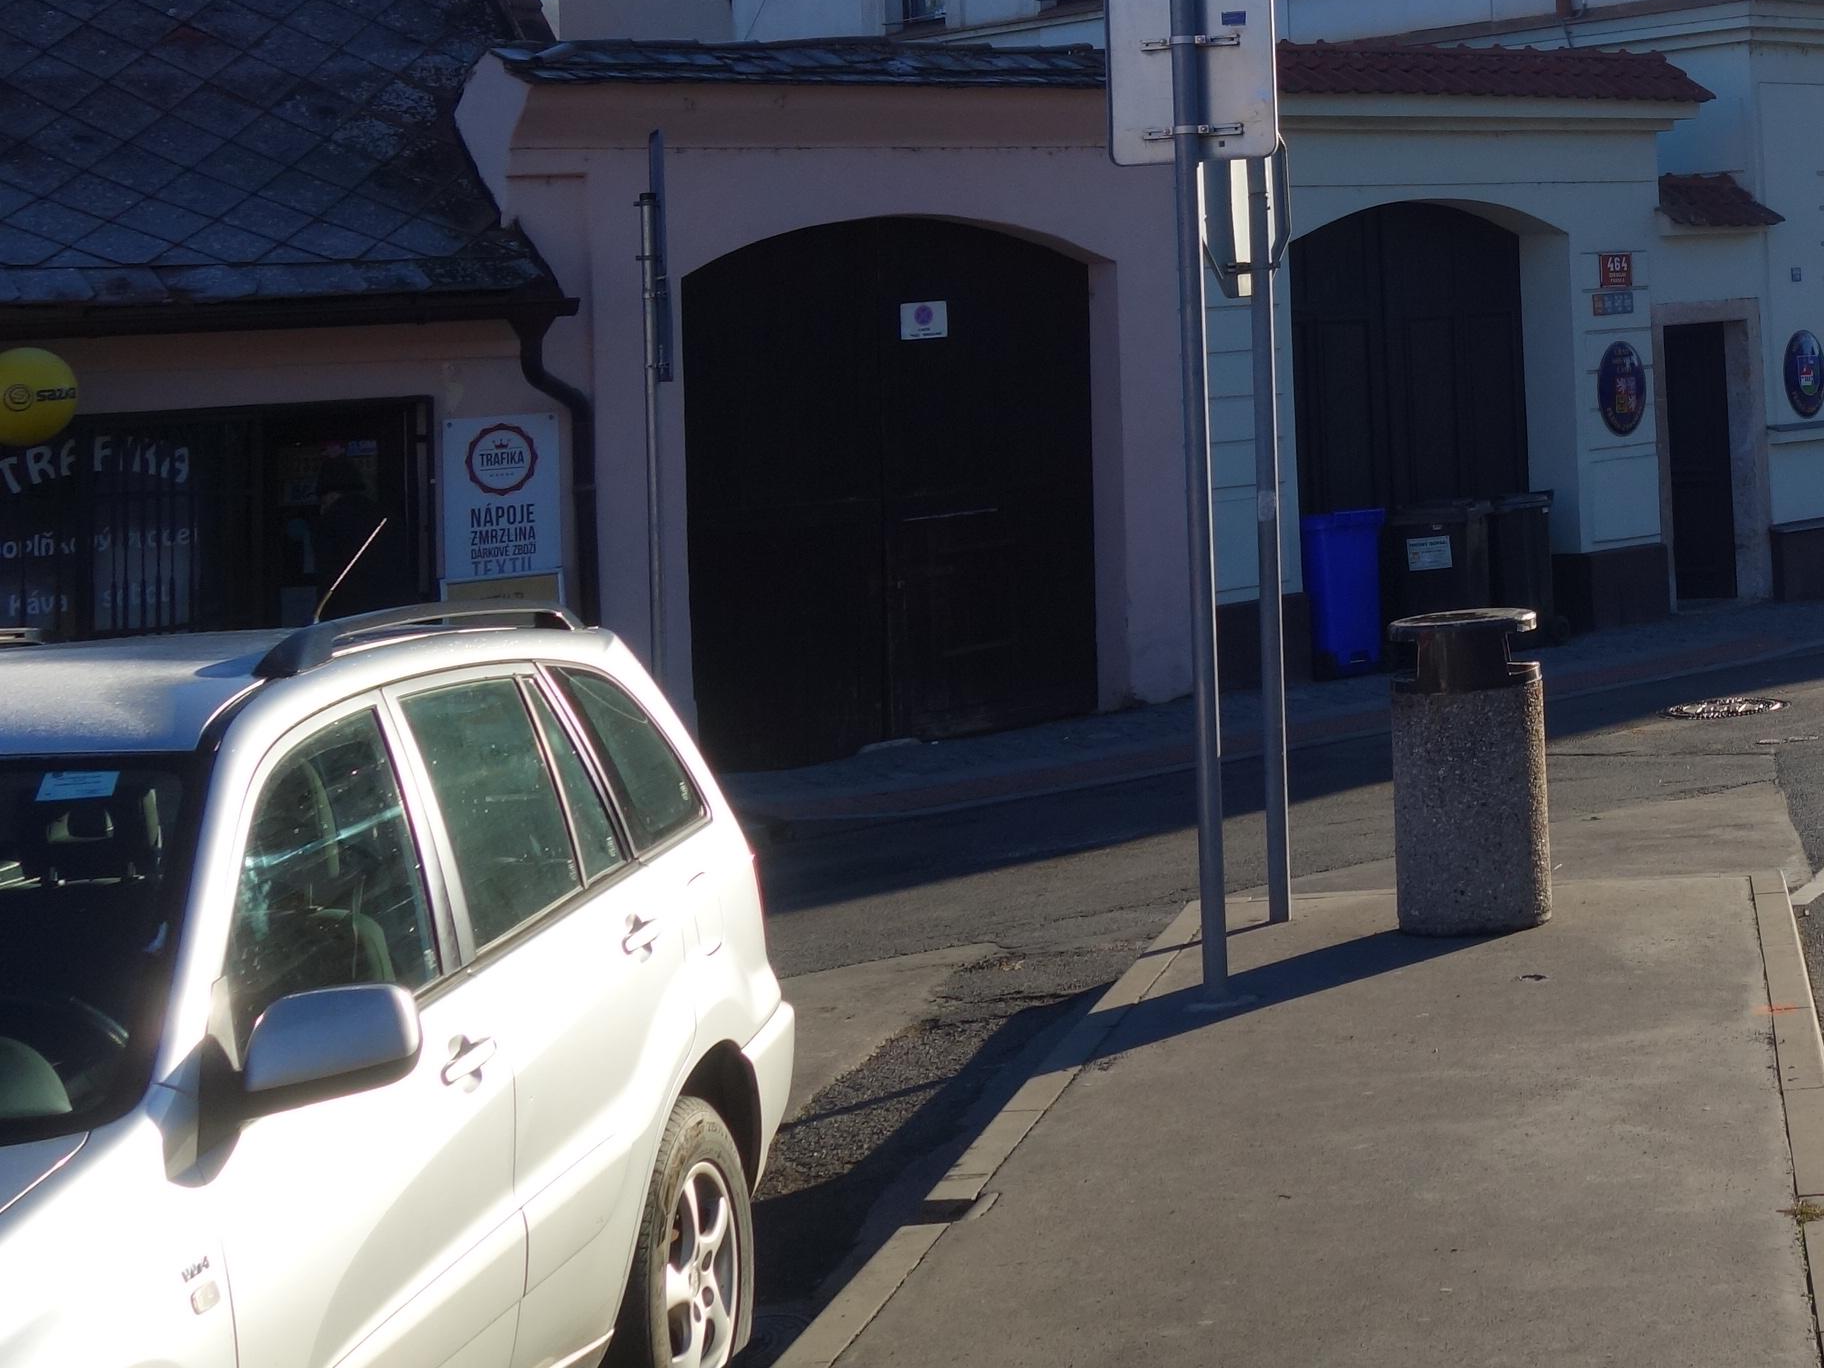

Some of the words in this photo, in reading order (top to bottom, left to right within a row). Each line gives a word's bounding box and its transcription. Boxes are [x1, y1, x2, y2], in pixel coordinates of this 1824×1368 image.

[1607, 256, 1628, 271] 464
[479, 450, 525, 467] TRAFIKA
[470, 503, 535, 528] NÁPOJE
[470, 526, 536, 546] ZMRZLINA
[471, 544, 510, 560] DÁRKOVÉ
